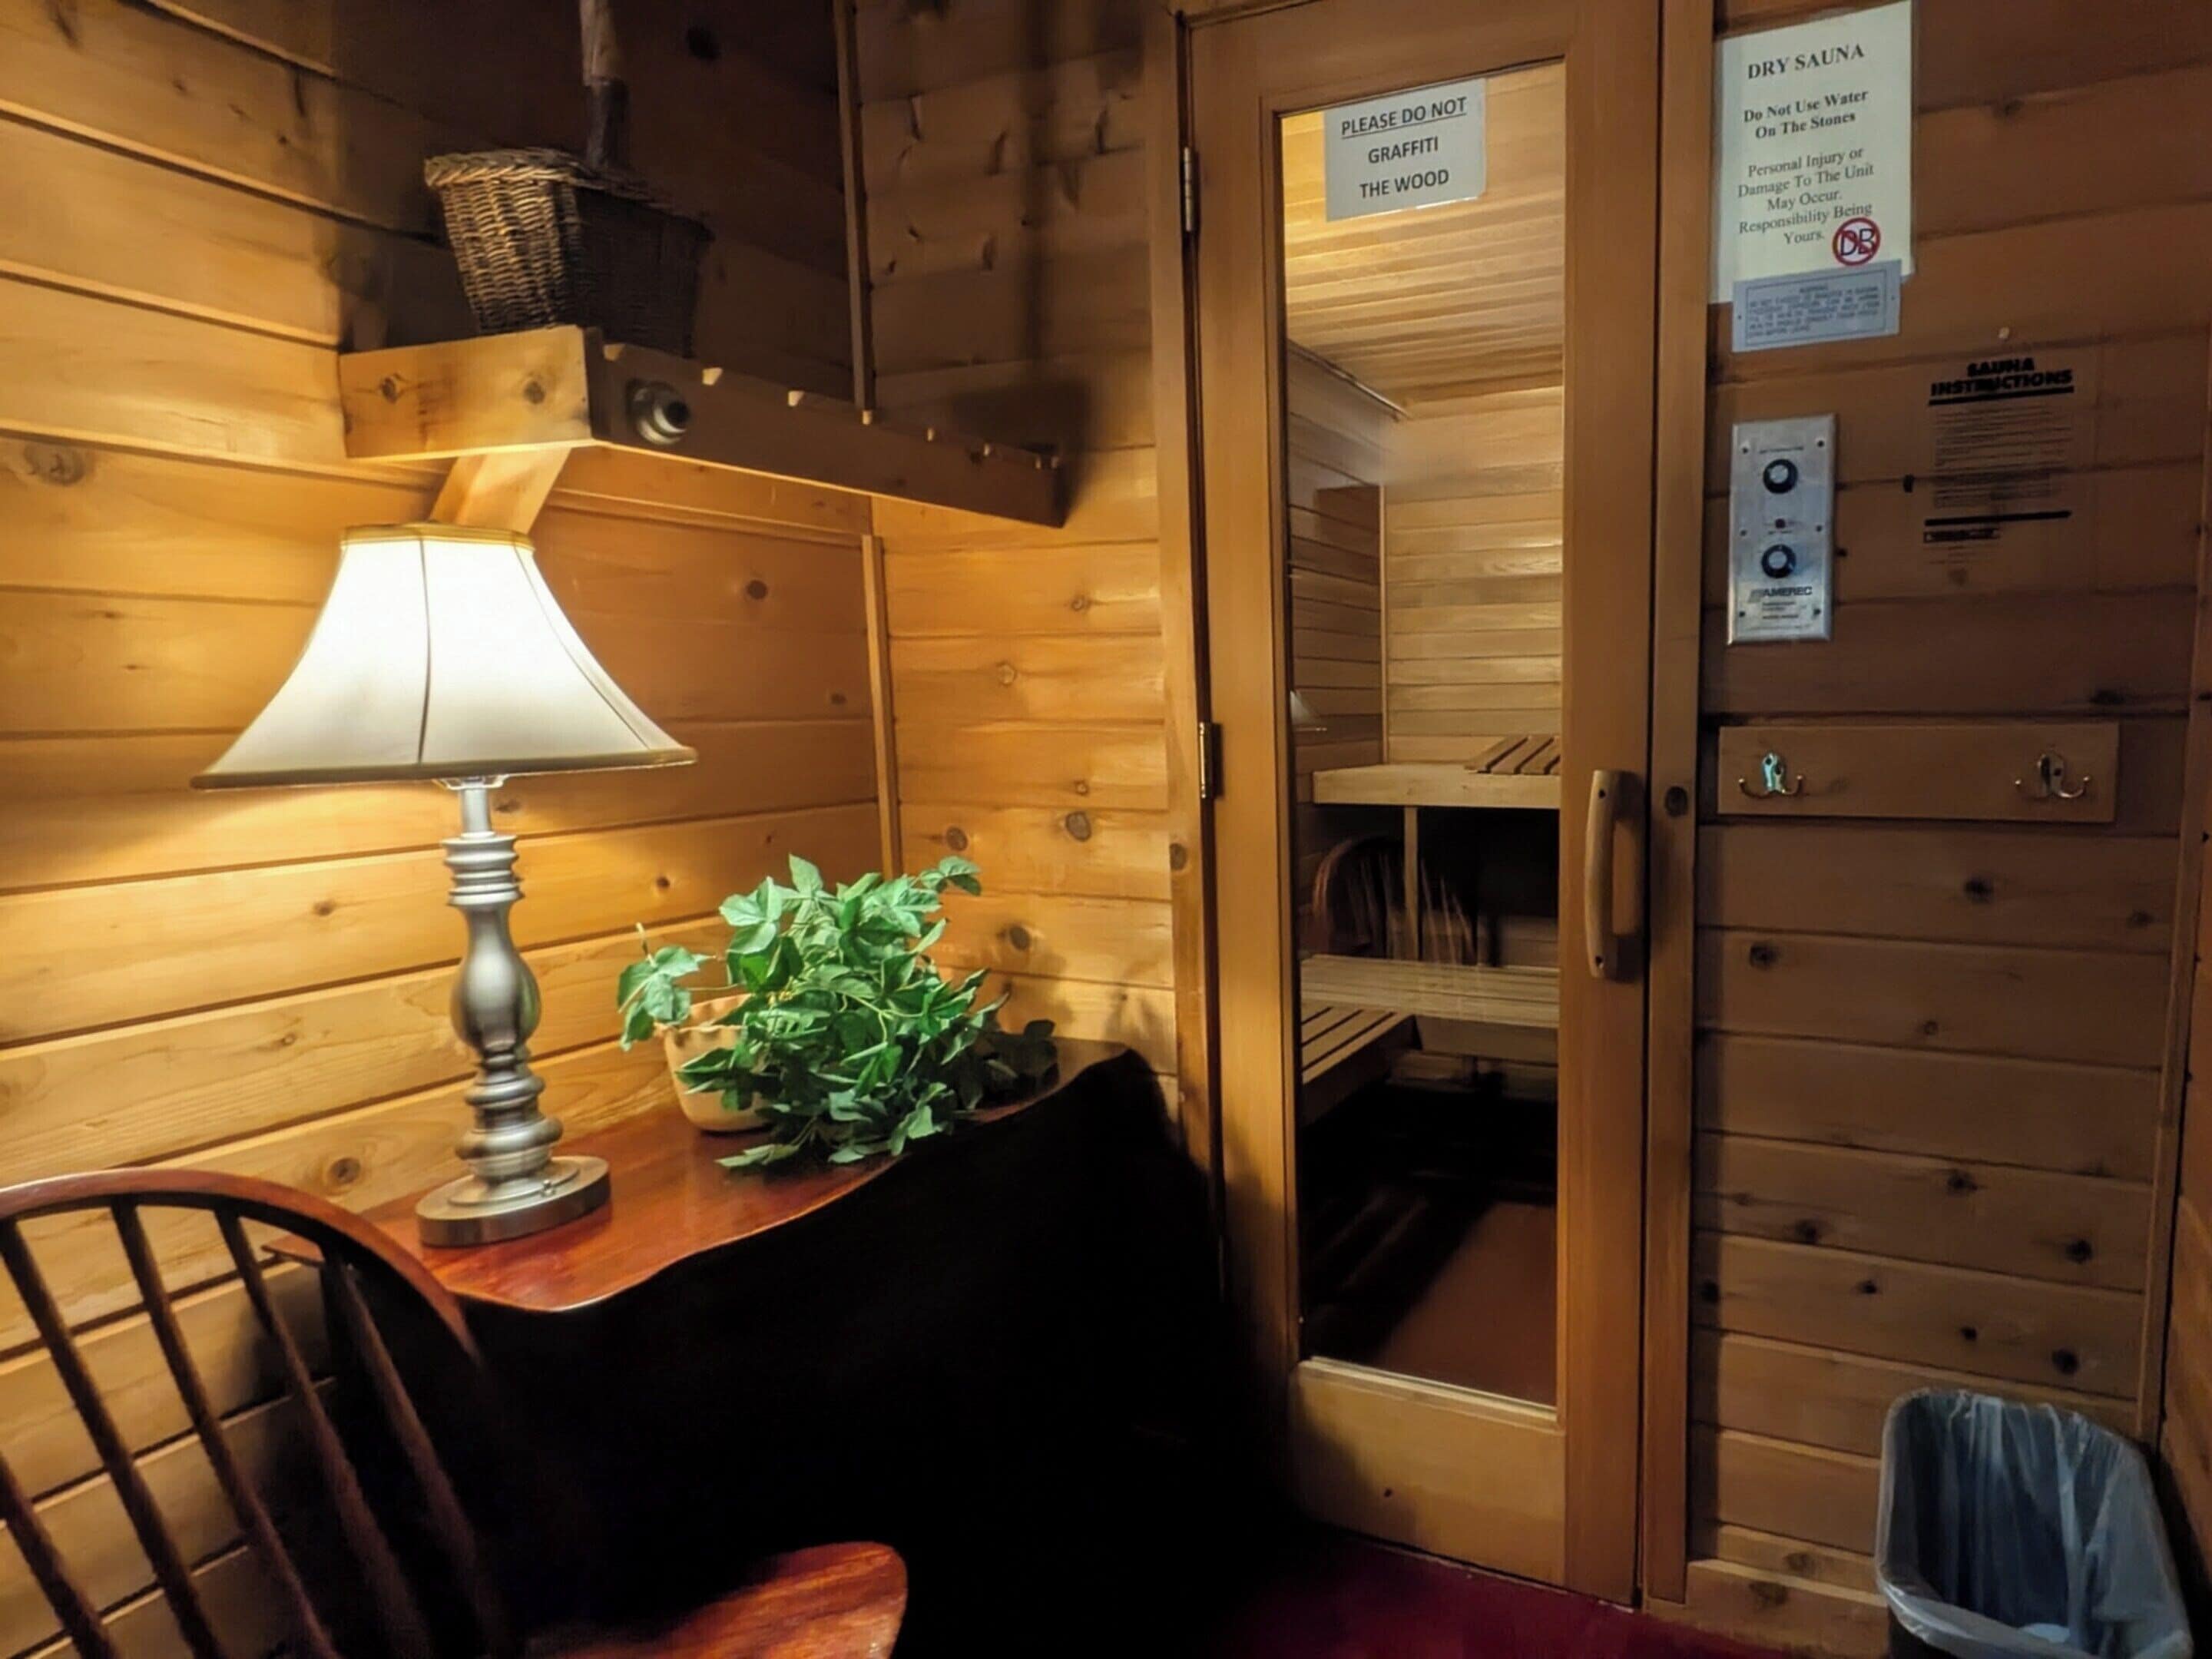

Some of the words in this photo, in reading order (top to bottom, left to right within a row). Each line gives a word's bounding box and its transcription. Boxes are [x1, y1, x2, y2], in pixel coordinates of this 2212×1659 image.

[1748, 56, 1790, 79] DRY
[1794, 44, 1865, 71] SAUNA
[1341, 111, 1397, 136] PLEASE
[1402, 105, 1426, 124] DO
[1432, 97, 1467, 118] NOT
[1743, 109, 1763, 123] Do
[1767, 104, 1791, 118] Not
[1796, 100, 1820, 113] Use
[1825, 90, 1868, 107] Water
[1755, 126, 1776, 139] On
[1781, 121, 1806, 135] The
[1810, 112, 1856, 130] Stones
[1368, 137, 1439, 164] GRAFFITI
[1748, 157, 1802, 177] Personal
[1806, 150, 1846, 169] Injury
[1849, 148, 1864, 159] or
[1359, 180, 1389, 199] THE
[1395, 169, 1449, 193] WOOD
[1738, 180, 1790, 198] Damage
[1794, 174, 1812, 188] To
[1816, 169, 1841, 184] The
[1845, 164, 1874, 177] Unit
[1767, 197, 1796, 212] May
[1800, 190, 1842, 205] Occur.
[1739, 210, 1831, 234] Responsibility
[1833, 202, 1873, 219] Being
[1783, 231, 1825, 246] Yours.
[1930, 369, 2073, 396] INSTRUCTIONS
